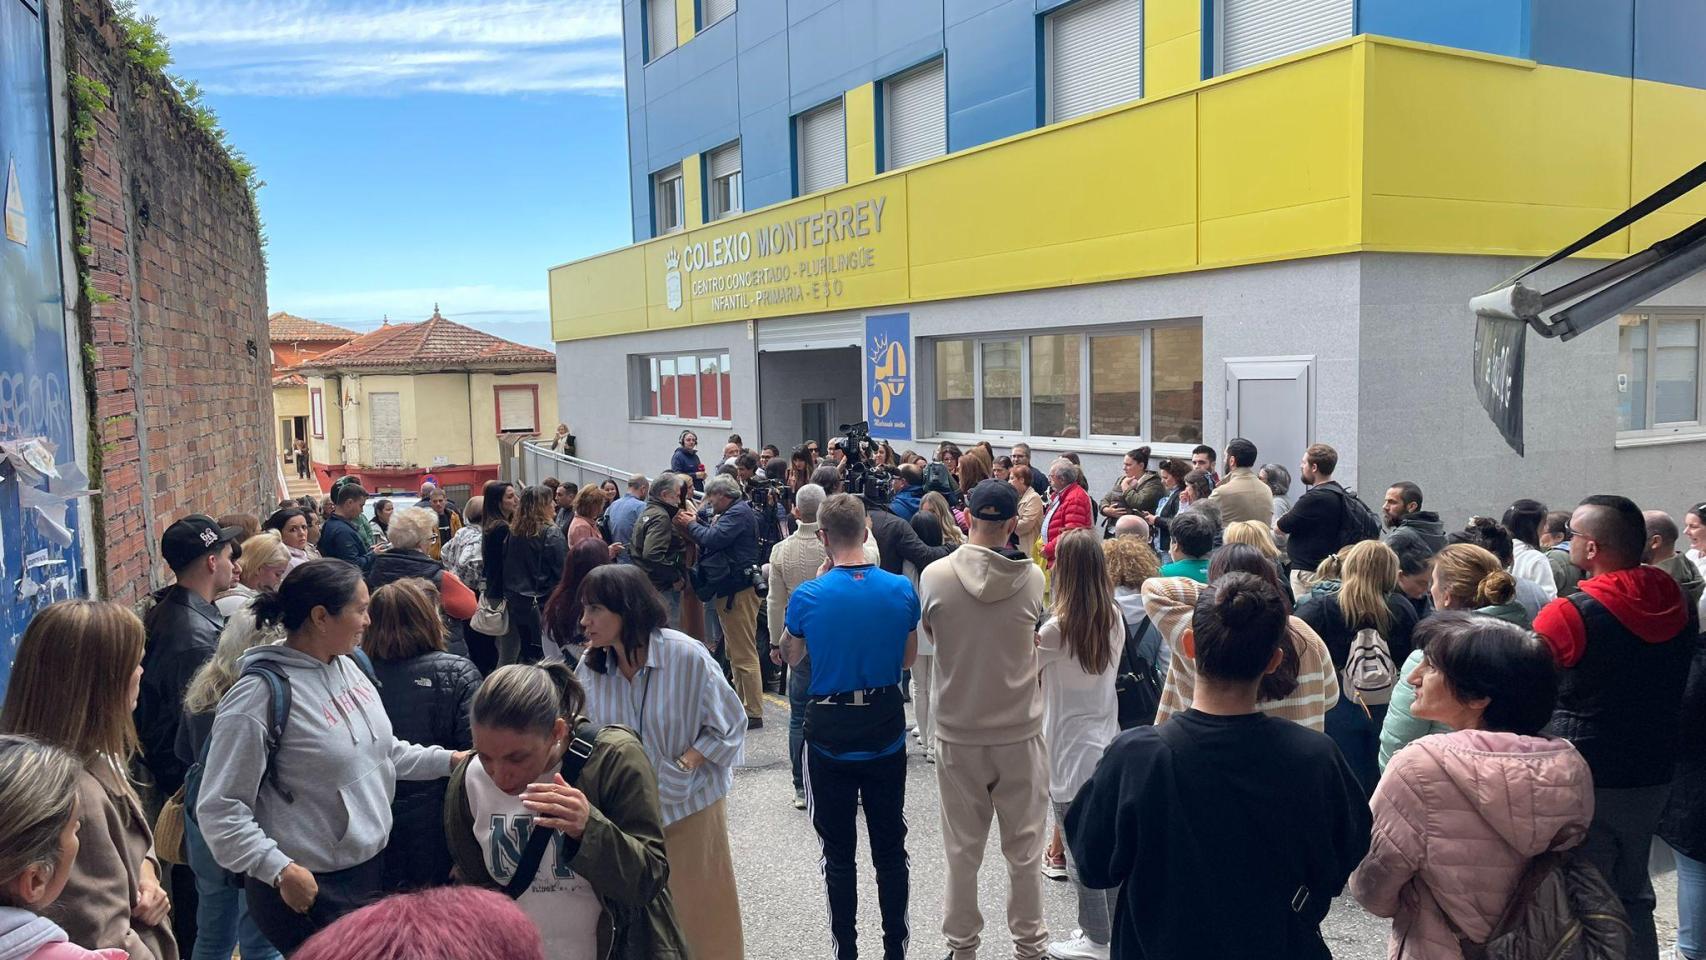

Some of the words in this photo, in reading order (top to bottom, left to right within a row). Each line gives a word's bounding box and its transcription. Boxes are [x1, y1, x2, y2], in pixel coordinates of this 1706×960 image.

[684, 232, 751, 272] COLEXIO
[757, 196, 886, 257] MONTERREY
[692, 276, 725, 296] CENTRO
[726, 265, 790, 291] CONCERTADO
[800, 247, 875, 277] PLURILINGÜE
[711, 294, 749, 312] INFANTIL
[756, 284, 804, 306] PRIMARIA
